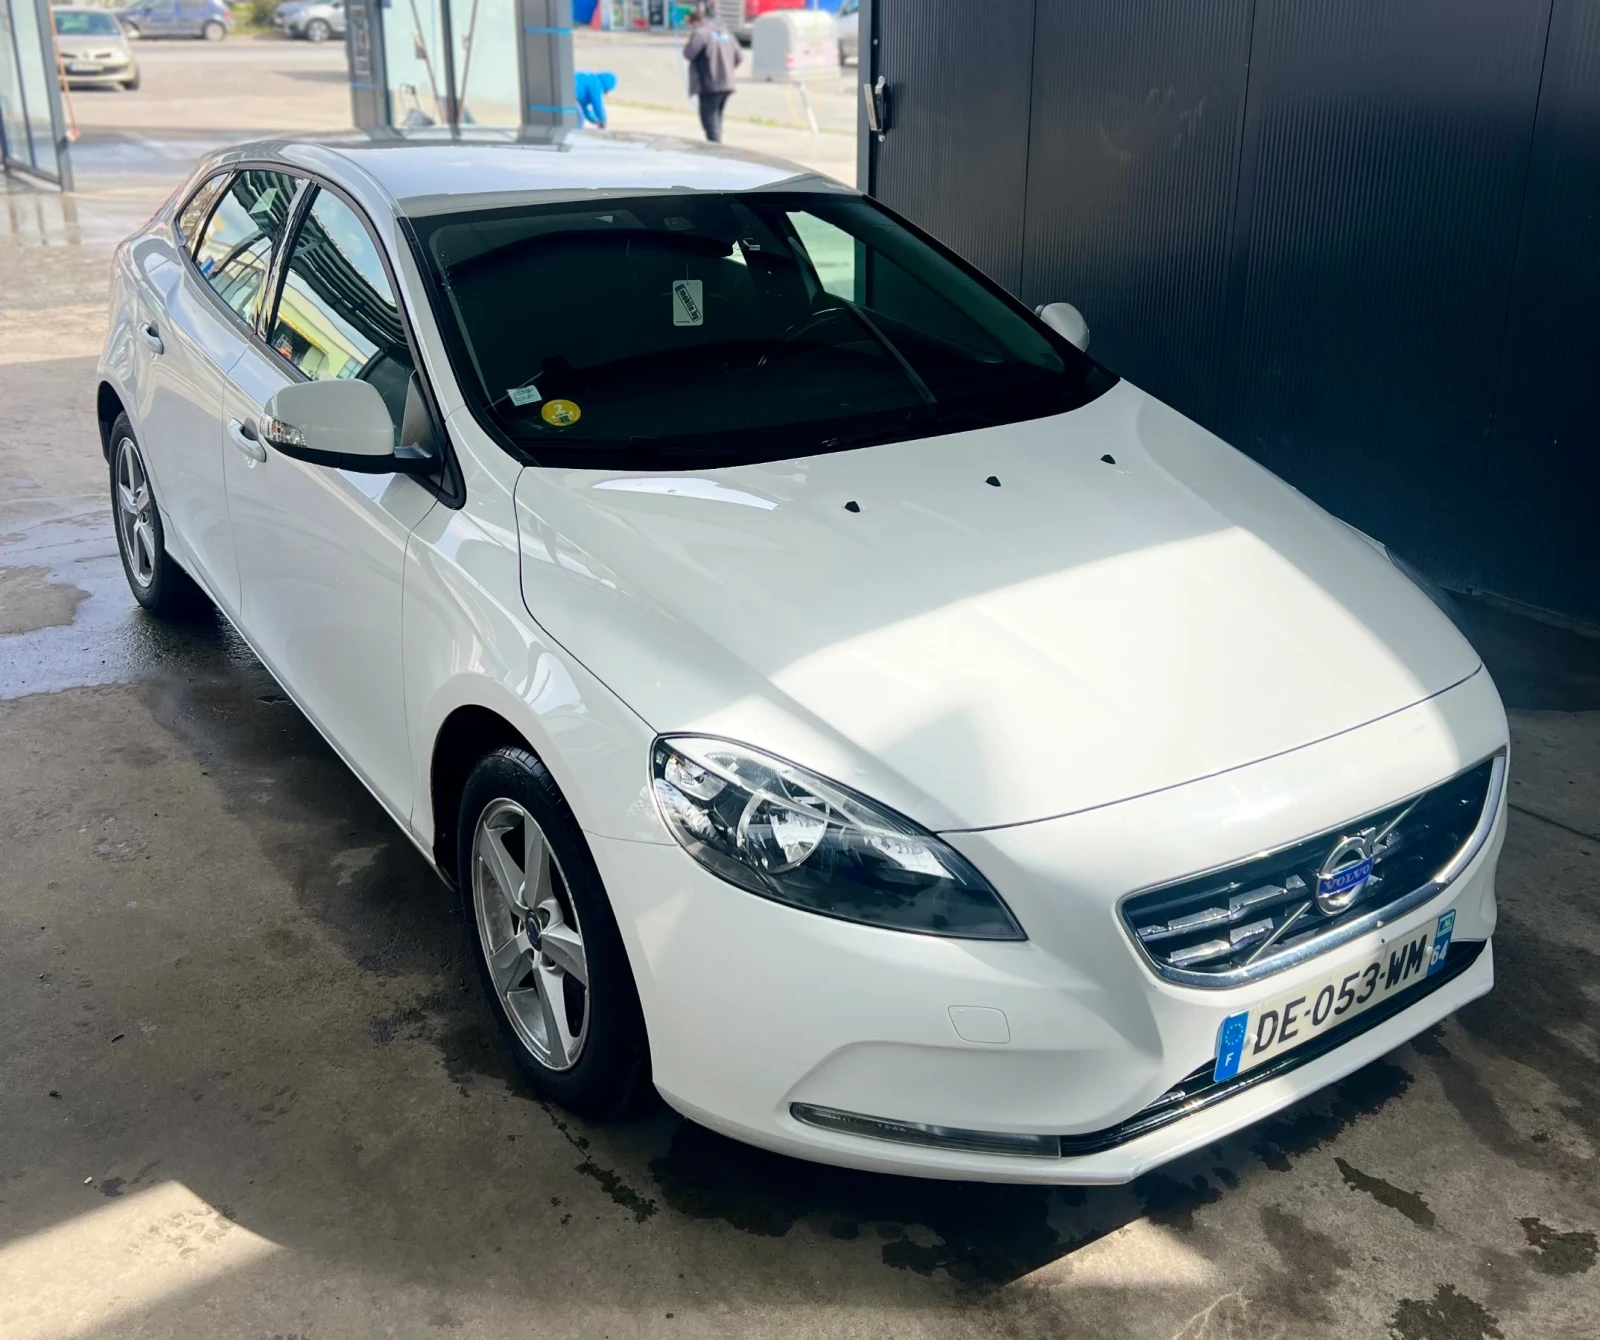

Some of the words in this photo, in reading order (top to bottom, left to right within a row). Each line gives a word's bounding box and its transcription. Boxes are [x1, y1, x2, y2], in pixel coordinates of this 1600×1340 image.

[679, 290, 699, 320] mobile.bg
[1324, 864, 1371, 890] VOLVO
[1430, 939, 1449, 966] 64
[1253, 934, 1428, 1055] DE-053-WM
[1225, 1052, 1235, 1067] F
